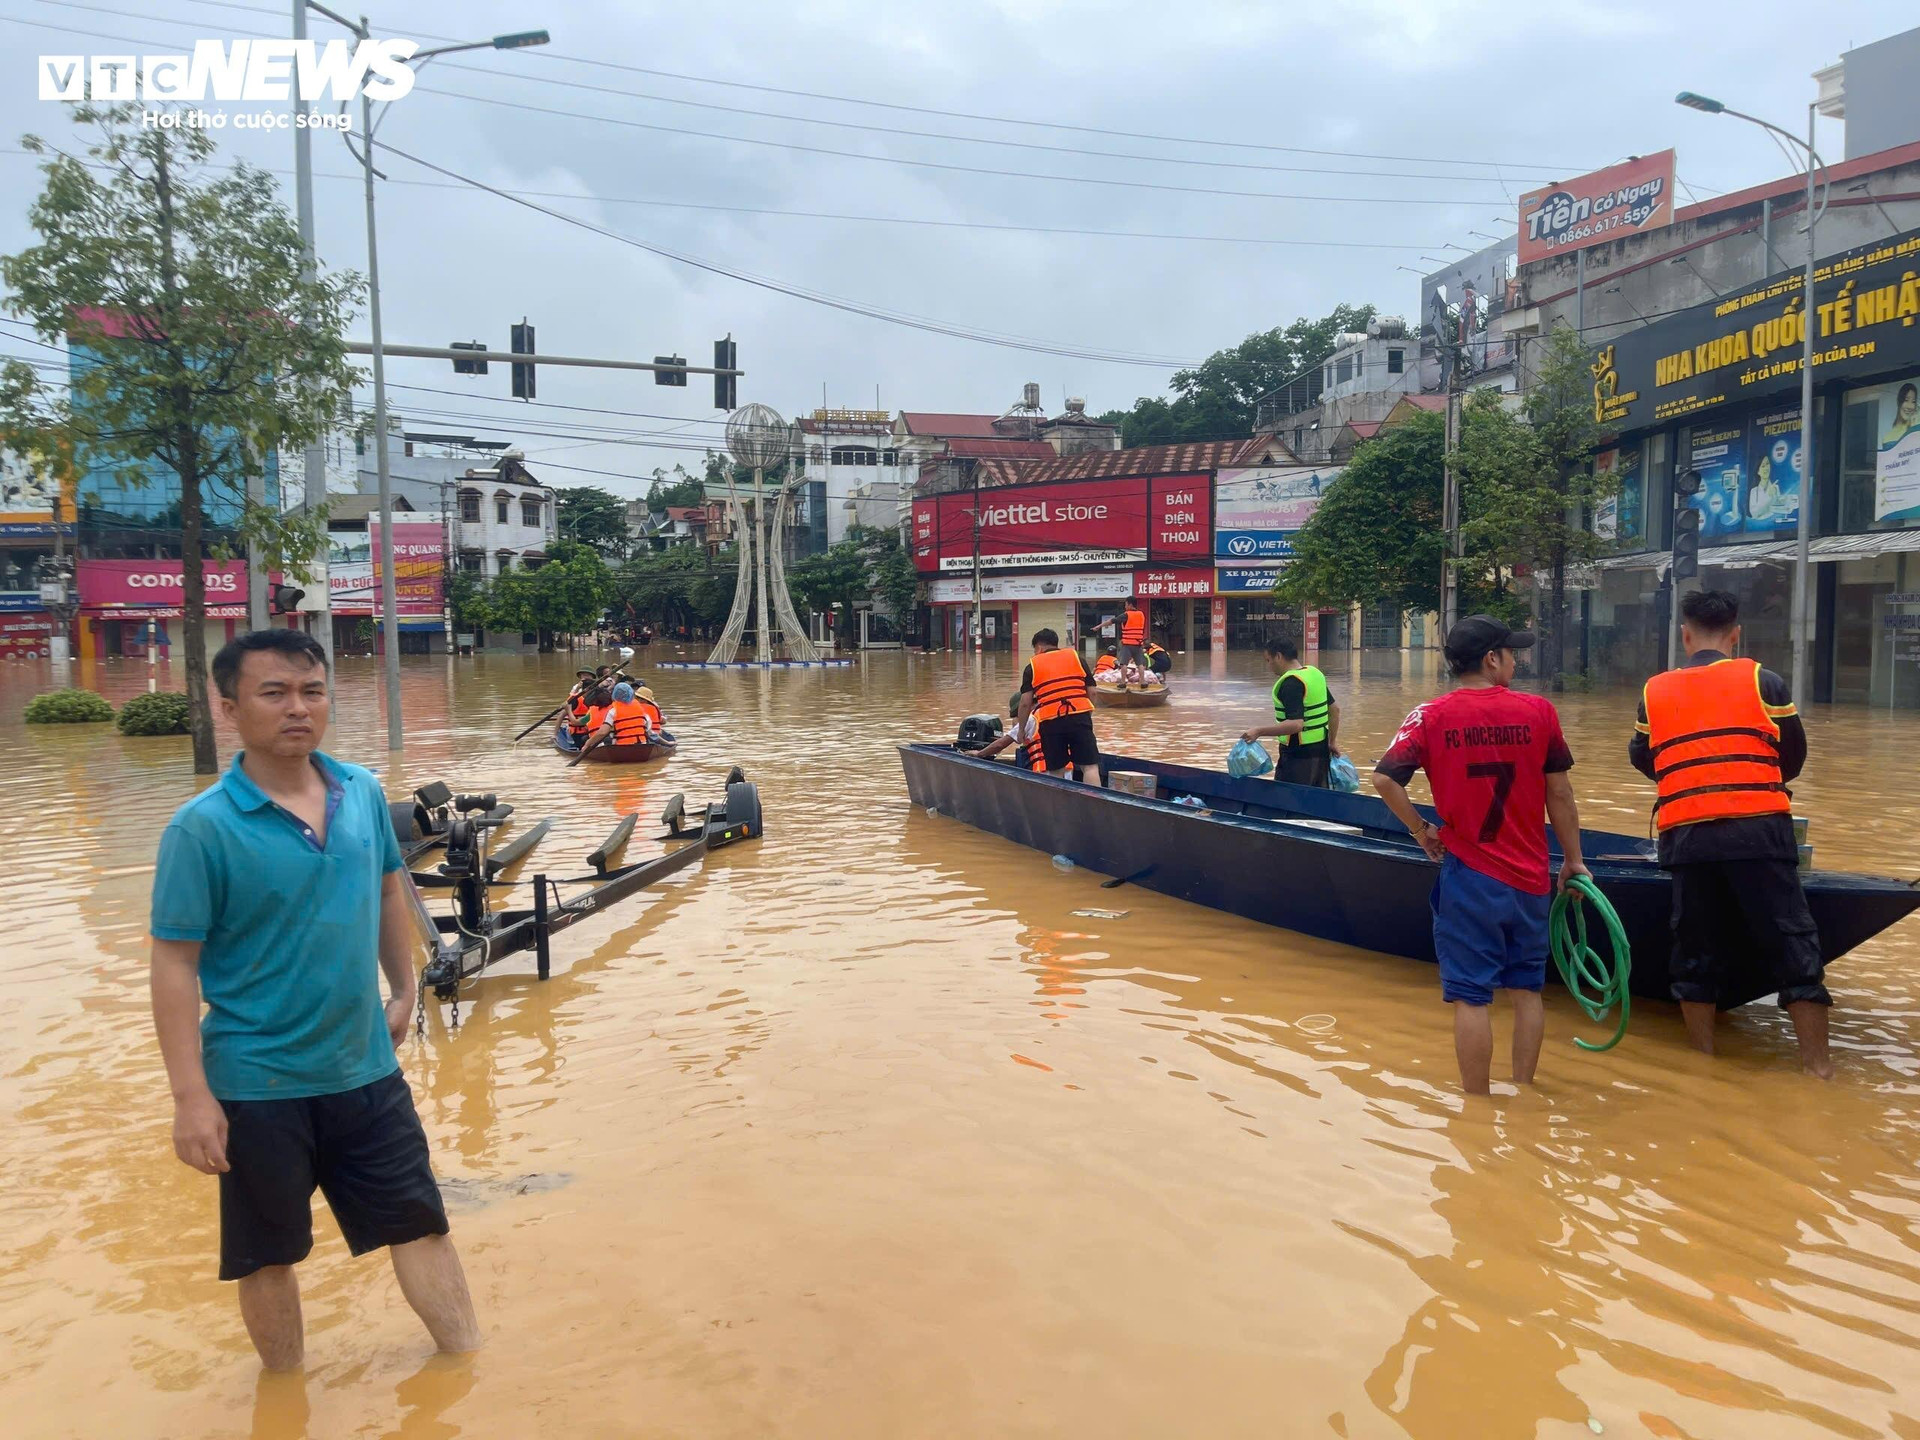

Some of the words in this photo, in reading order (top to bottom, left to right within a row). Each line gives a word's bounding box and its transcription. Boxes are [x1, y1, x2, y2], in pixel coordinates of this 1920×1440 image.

[1526, 196, 1591, 241] Tiền
[1593, 192, 1614, 214] Có
[1616, 177, 1662, 206] Ngay
[1559, 204, 1650, 245] 0866.617.559
[1741, 288, 1766, 308] KHÁM
[1655, 349, 1693, 387] NHA
[1695, 329, 1750, 374] KHOA
[1817, 279, 1856, 338] TẾ
[1740, 367, 1757, 386] TẤT
[1798, 351, 1824, 369] CỜI
[1825, 345, 1848, 362] CỦA
[1849, 341, 1876, 359] BẠN
[1165, 490, 1194, 506] BÁN
[978, 502, 1050, 527] viettel
[1055, 504, 1108, 522] store
[1164, 511, 1195, 527] ĐIỆN
[1160, 530, 1200, 545] THOẠI
[1258, 540, 1293, 549] VIETH
[408, 544, 443, 556] QUANG
[1070, 551, 1080, 561] SỐ
[126, 573, 238, 593] concng
[1240, 570, 1261, 578] ĐẠP
[1138, 582, 1148, 594] XE
[1148, 582, 1163, 595] ĐẠP
[1167, 582, 1178, 594] XE
[1178, 582, 1193, 595] ĐẠP
[1193, 579, 1210, 595] ĐIỆN
[1444, 729, 1460, 749] FC
[1466, 761, 1516, 844] 7
